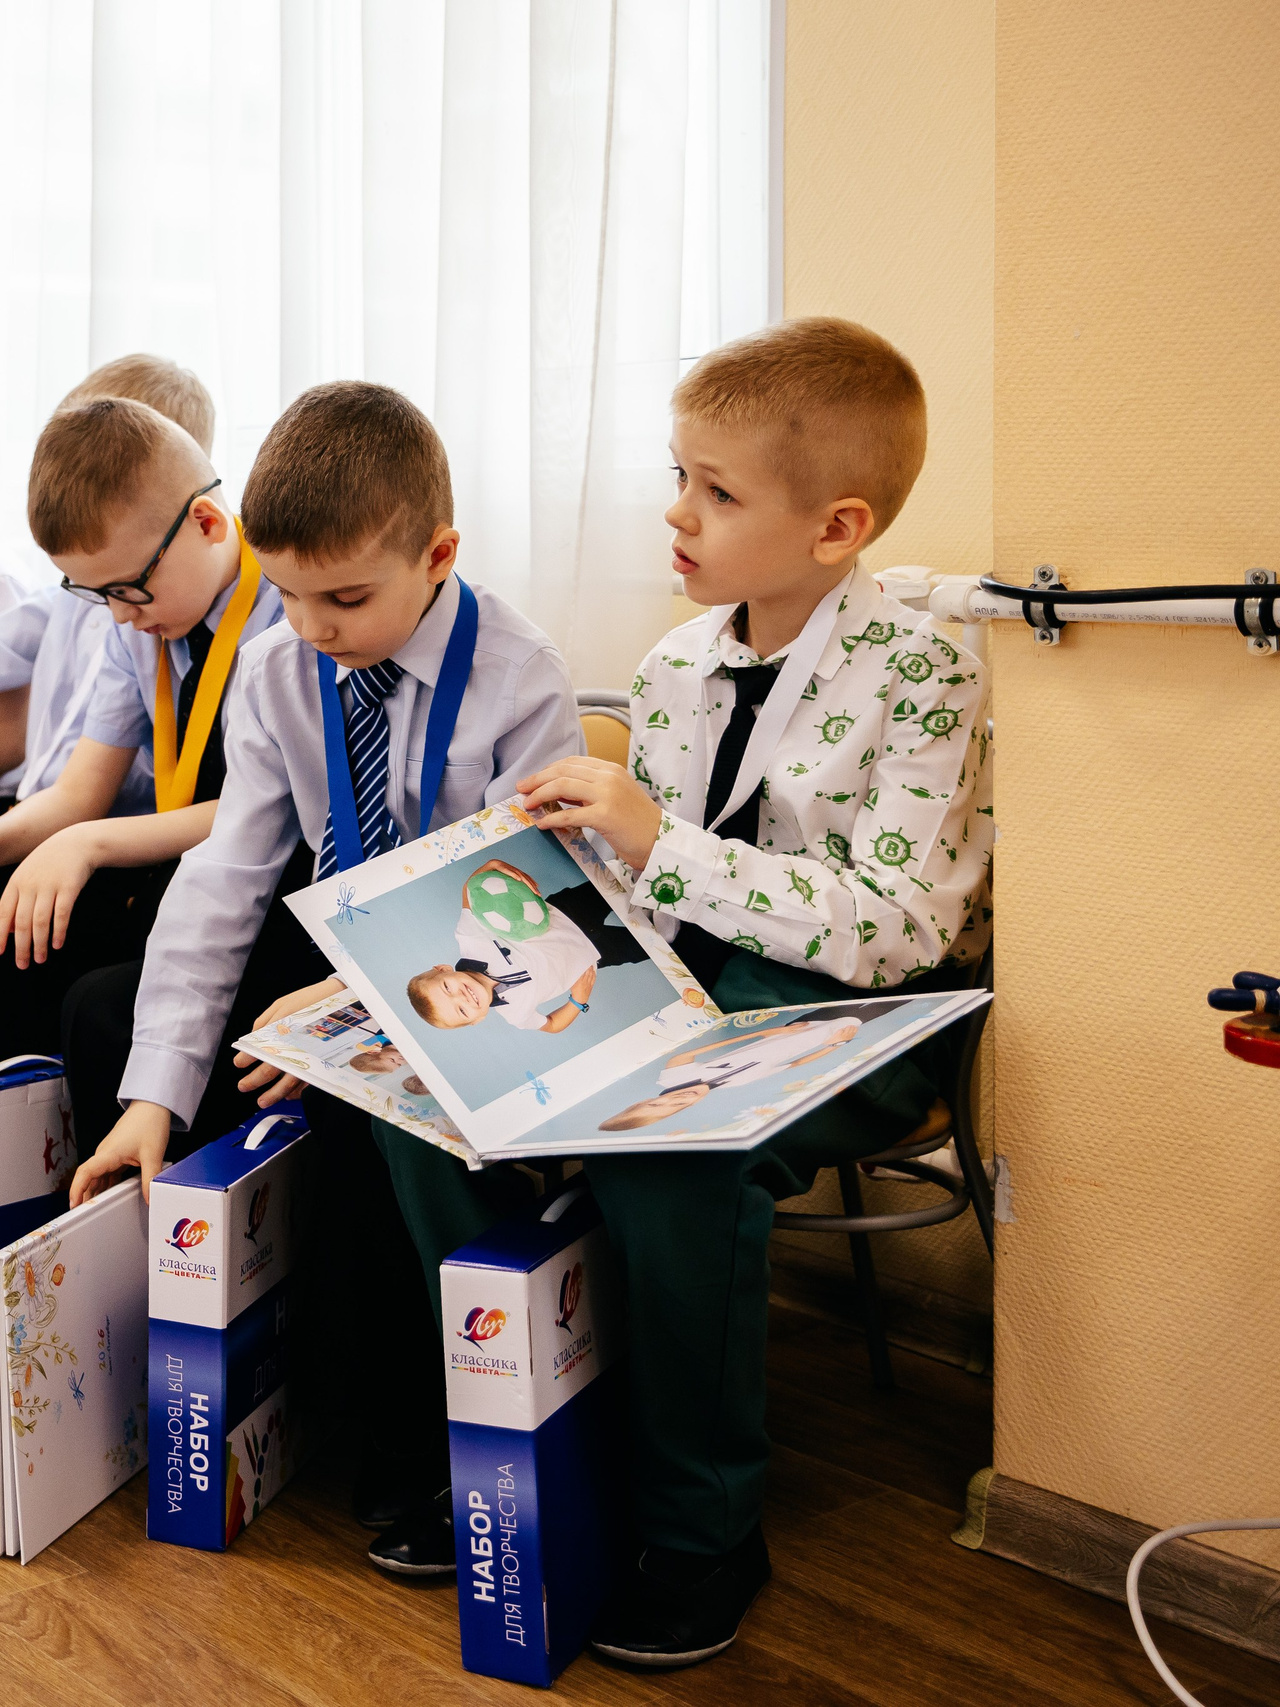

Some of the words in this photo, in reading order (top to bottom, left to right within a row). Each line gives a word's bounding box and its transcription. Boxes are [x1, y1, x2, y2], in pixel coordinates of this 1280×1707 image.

[975, 608, 999, 616] AQUA
[1193, 616, 1235, 624] 32415-201
[158, 1258, 217, 1276] классика
[174, 1270, 201, 1280] ЦВЕТА
[451, 1353, 518, 1371] классика
[552, 1329, 592, 1371] классика
[165, 1353, 183, 1392] ДЛЯ
[469, 1366, 500, 1376] ЦВЕТА
[167, 1398, 183, 1513] ТВОРЧЕСТВА
[189, 1392, 209, 1492] НАБОР
[468, 1490, 496, 1603] НАБОР
[497, 1463, 521, 1596] ТВОРЧЕСТВА
[504, 1602, 527, 1647] ДЛЯ
